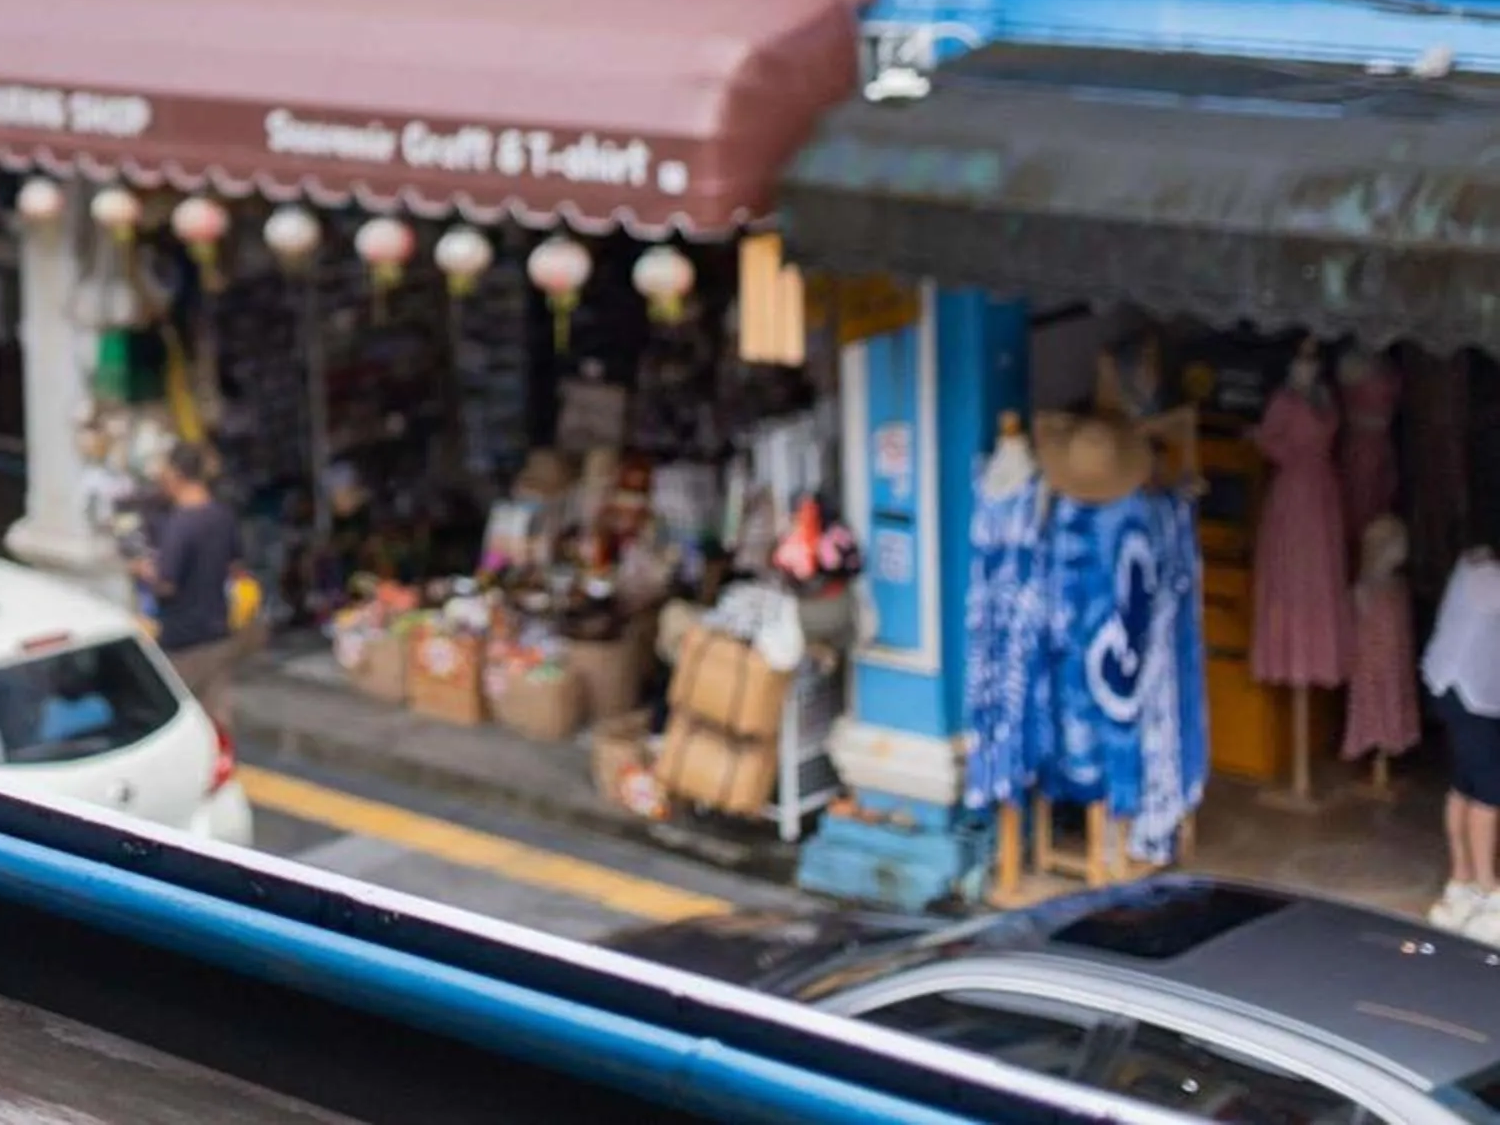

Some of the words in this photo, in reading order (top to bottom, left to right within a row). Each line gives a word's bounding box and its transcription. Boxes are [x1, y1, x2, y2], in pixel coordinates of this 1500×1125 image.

[70, 89, 152, 138] SHOP
[402, 121, 492, 170] Craft
[526, 131, 650, 187] T-shirt
